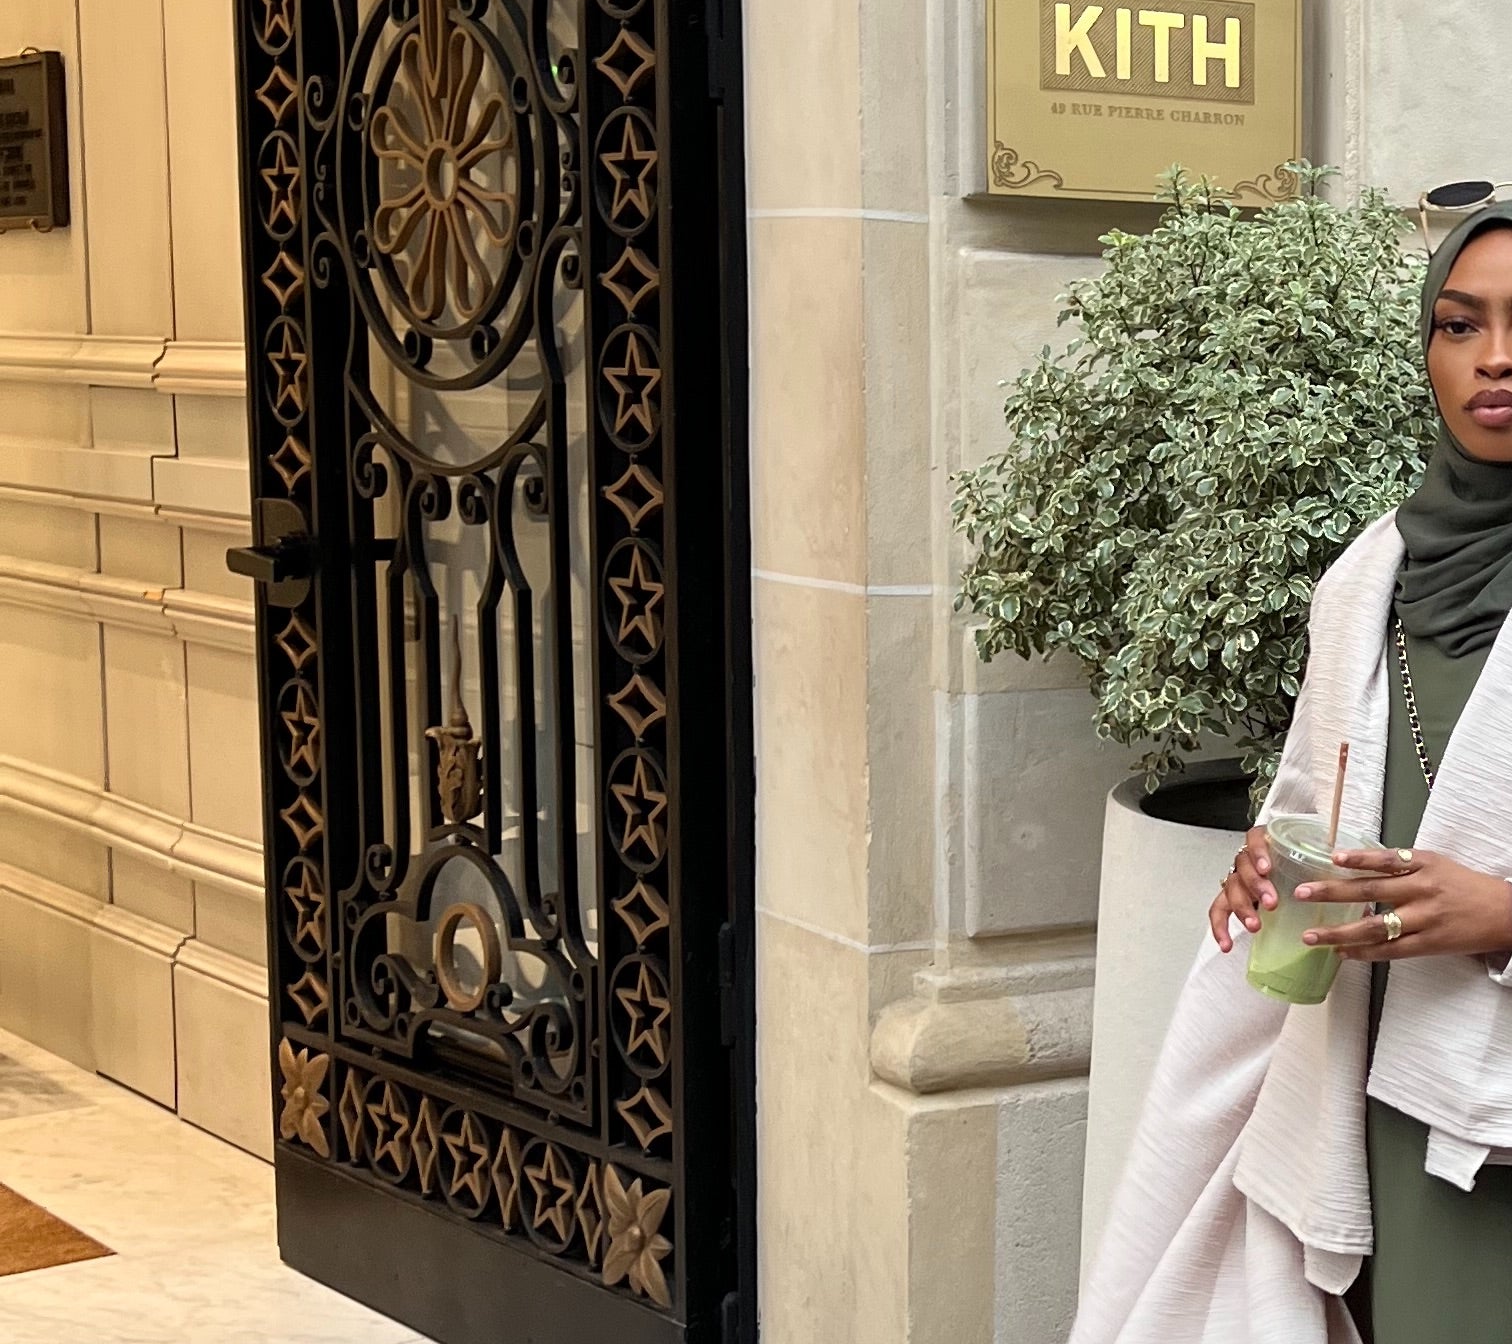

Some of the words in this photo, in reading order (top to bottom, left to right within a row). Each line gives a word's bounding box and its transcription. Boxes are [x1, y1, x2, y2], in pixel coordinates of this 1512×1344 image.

[1055, 3, 1241, 88] KITH
[1071, 103, 1103, 117] RUE
[1107, 105, 1165, 121] PIERRE
[1170, 110, 1245, 126] CHARRON
